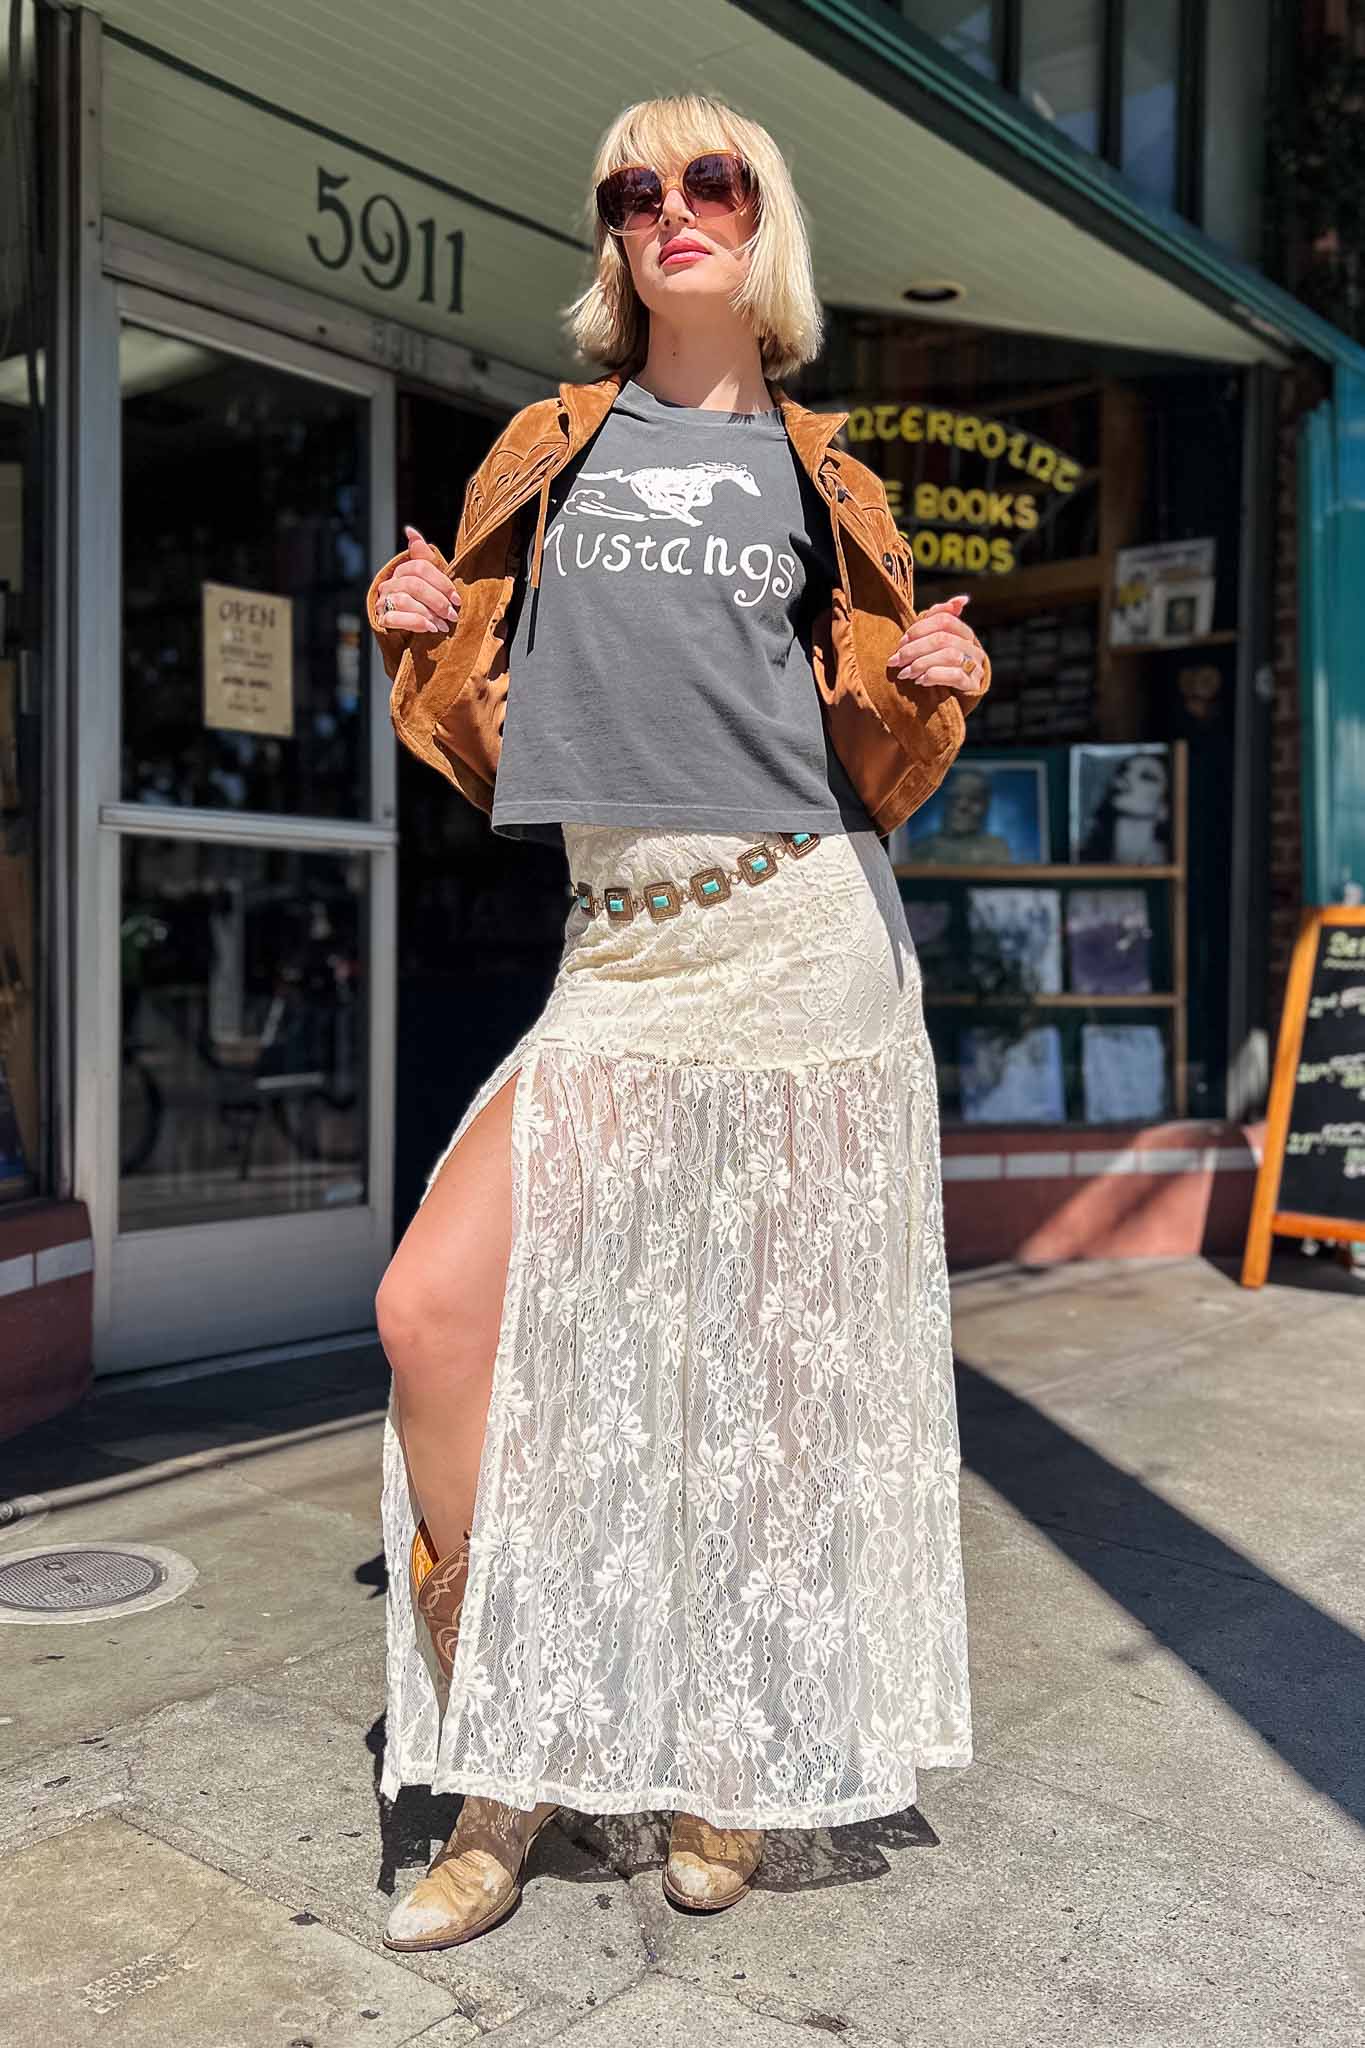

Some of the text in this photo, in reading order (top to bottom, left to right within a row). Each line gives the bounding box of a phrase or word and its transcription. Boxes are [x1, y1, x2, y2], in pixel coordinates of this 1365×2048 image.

[306, 165, 464, 314] 5911
[849, 405, 1082, 493] NTERPOINT
[914, 482, 1039, 530] BOOKS
[899, 530, 1015, 574] ORDS
[219, 600, 276, 628] OPEN
[48, 1579, 126, 1600] SEWER
